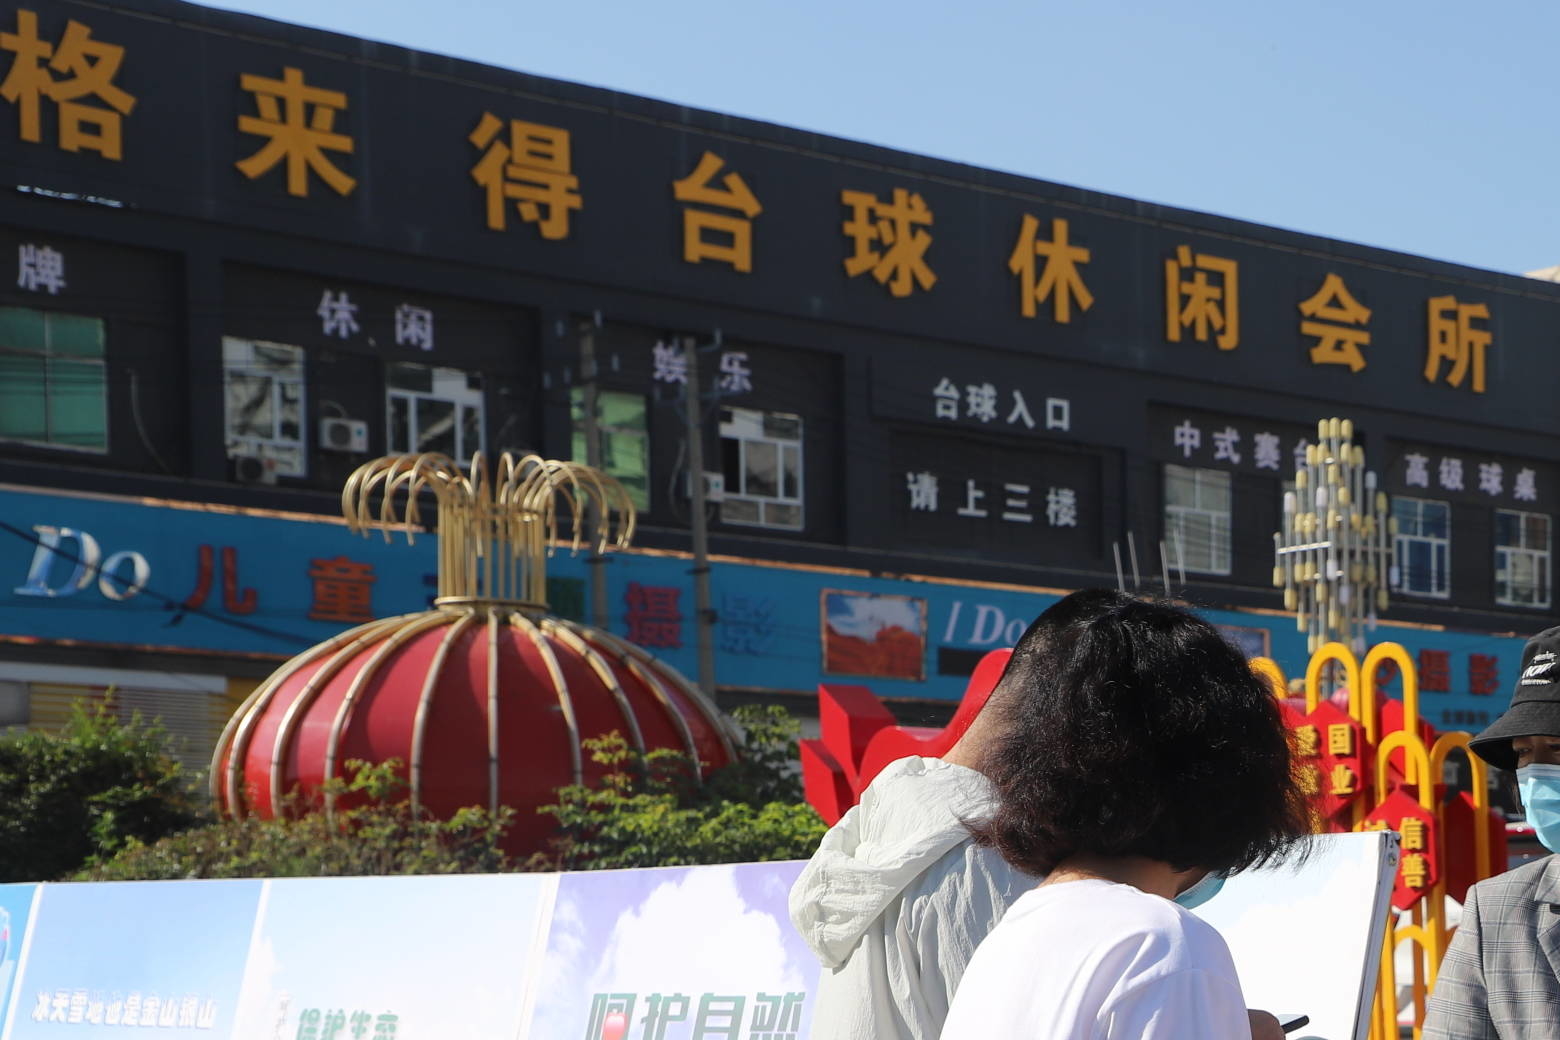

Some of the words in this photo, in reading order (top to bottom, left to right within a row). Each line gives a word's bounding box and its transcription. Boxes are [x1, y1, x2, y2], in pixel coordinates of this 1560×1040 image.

[0, 9, 1494, 394] 格来得台球休闲会所
[17, 243, 66, 295] 牌
[317, 290, 435, 350] 休闲
[933, 378, 1071, 432] 台球入口
[906, 472, 1078, 527] 请上三楼
[1404, 452, 1539, 501] 高级球桌
